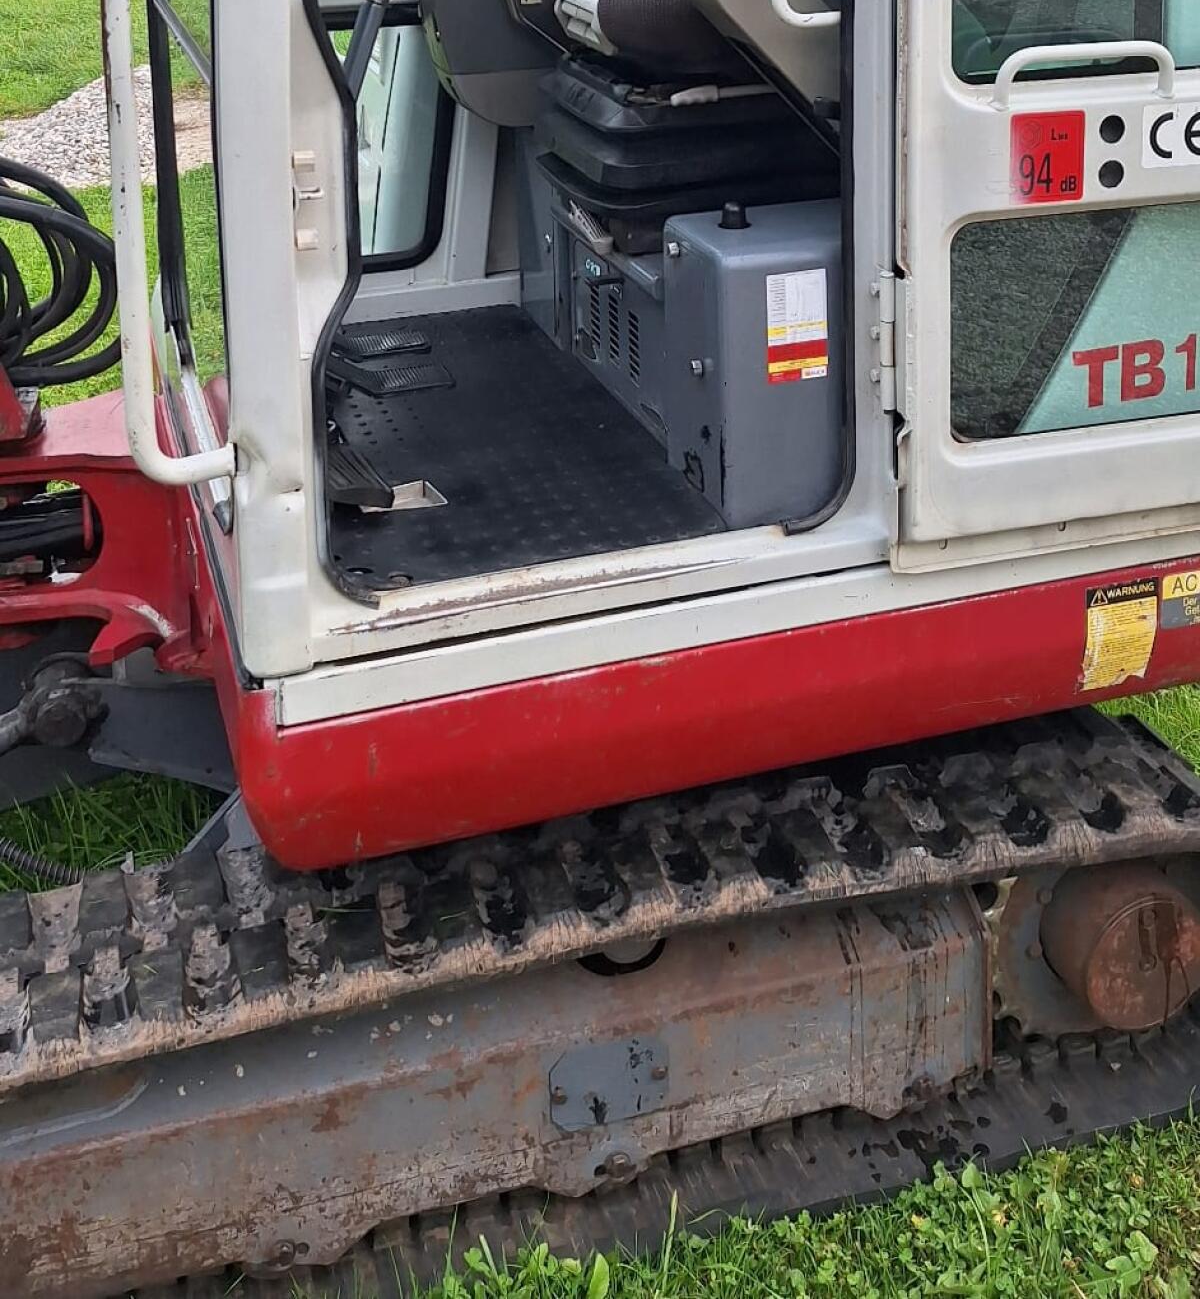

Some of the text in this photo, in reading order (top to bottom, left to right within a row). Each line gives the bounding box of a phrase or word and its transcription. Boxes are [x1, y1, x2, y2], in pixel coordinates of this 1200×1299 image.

[1018, 152, 1077, 196] 94 dB
[1106, 581, 1155, 599] WARNUNG
[1171, 573, 1197, 595] AC
